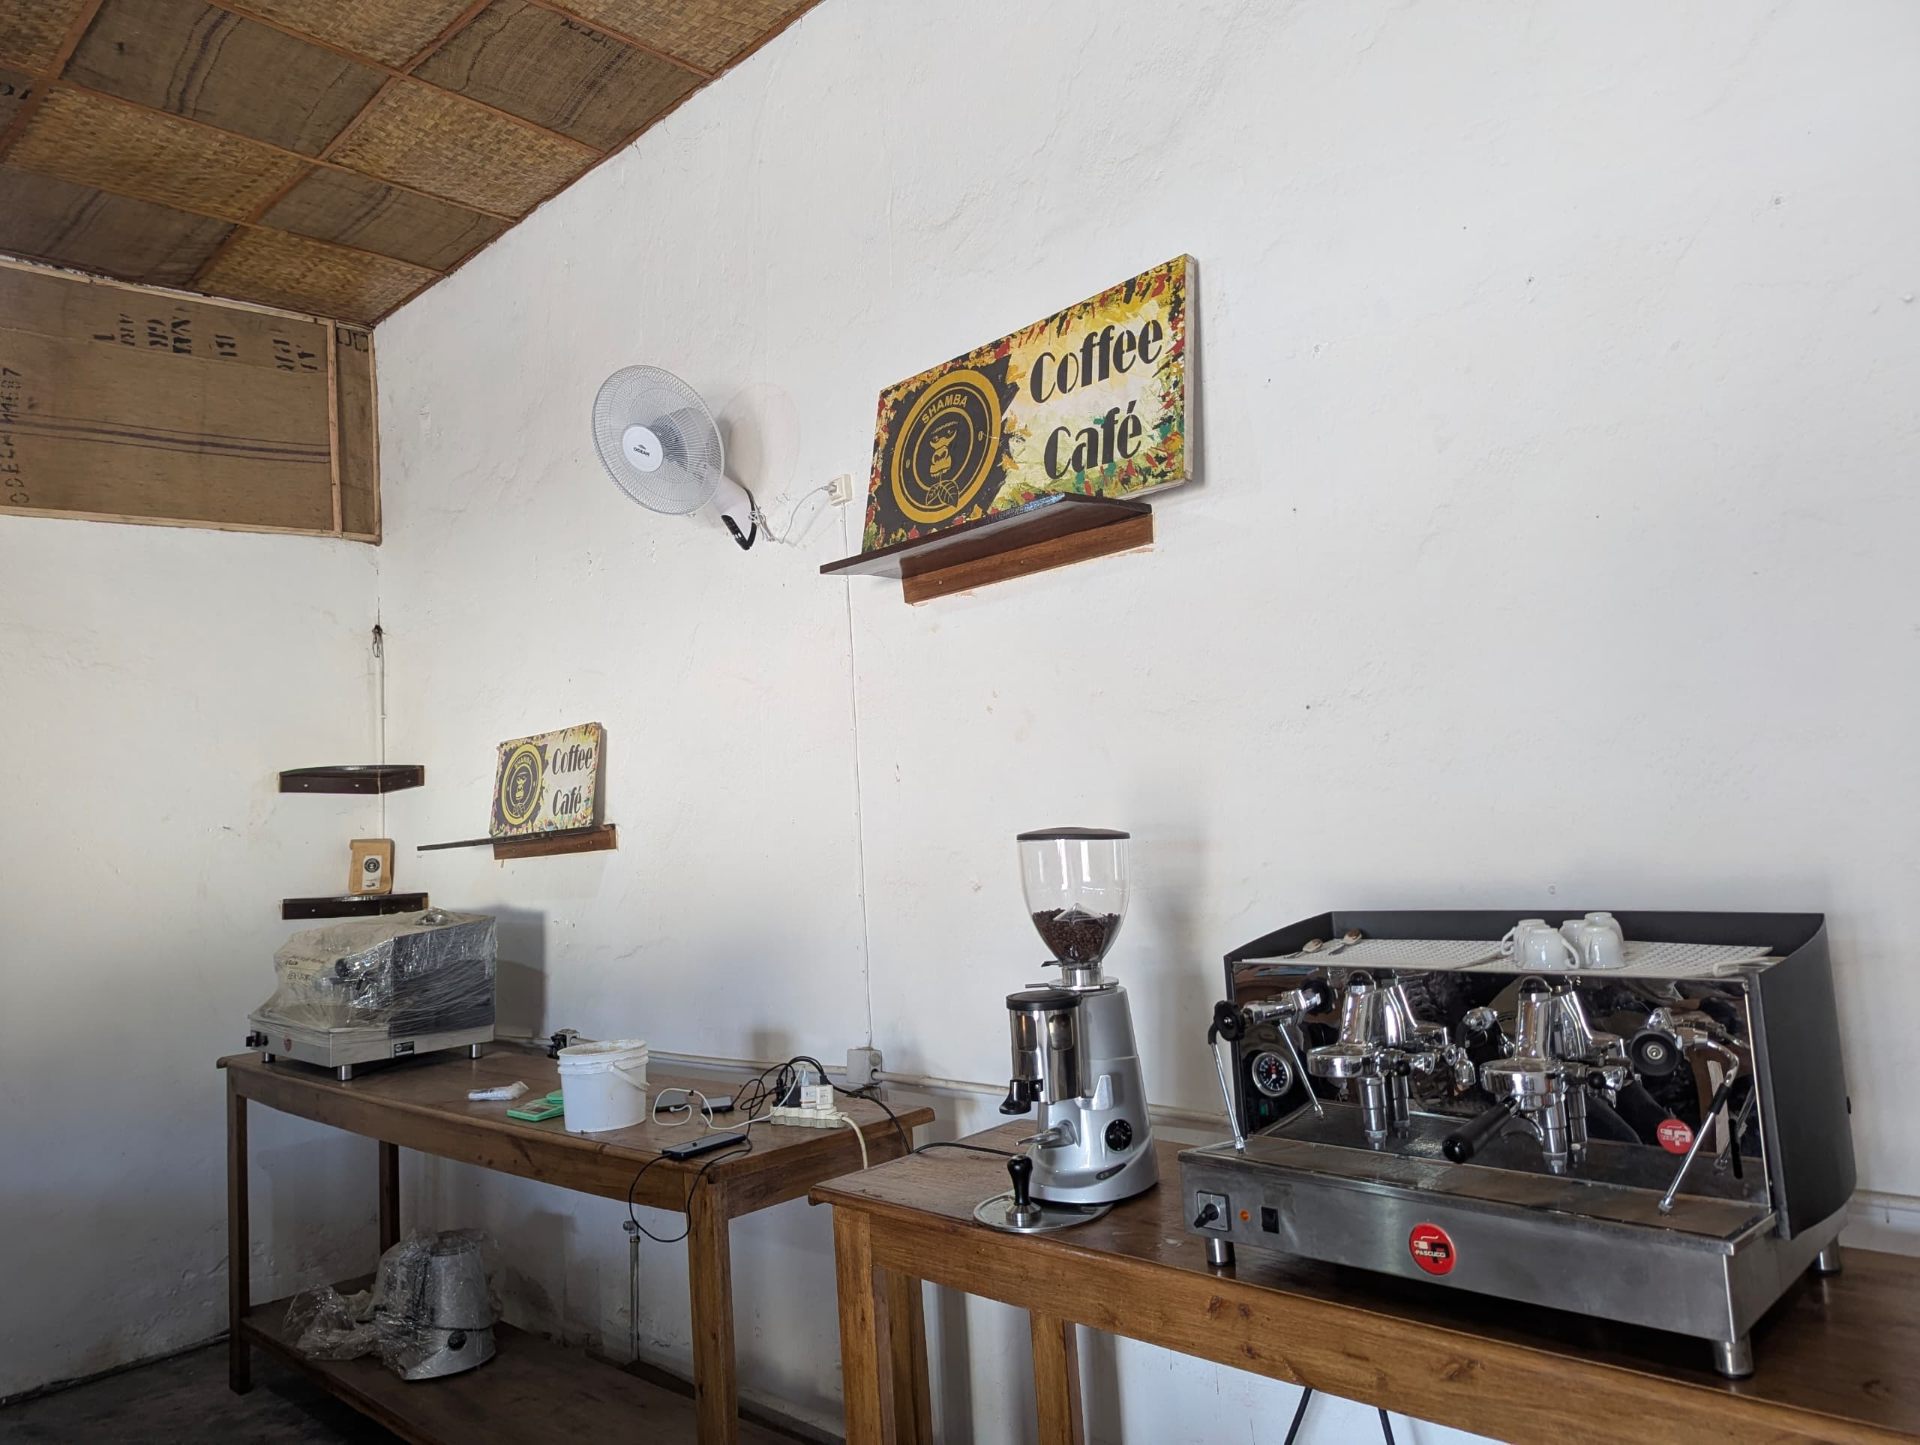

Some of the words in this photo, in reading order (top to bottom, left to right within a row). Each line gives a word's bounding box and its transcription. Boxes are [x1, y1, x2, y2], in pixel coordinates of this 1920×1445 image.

[1029, 319, 1164, 403] Coffee
[921, 393, 968, 425] SHAMBA
[1043, 399, 1142, 480] Café
[552, 743, 593, 775] Coffee
[552, 785, 581, 817] Café
